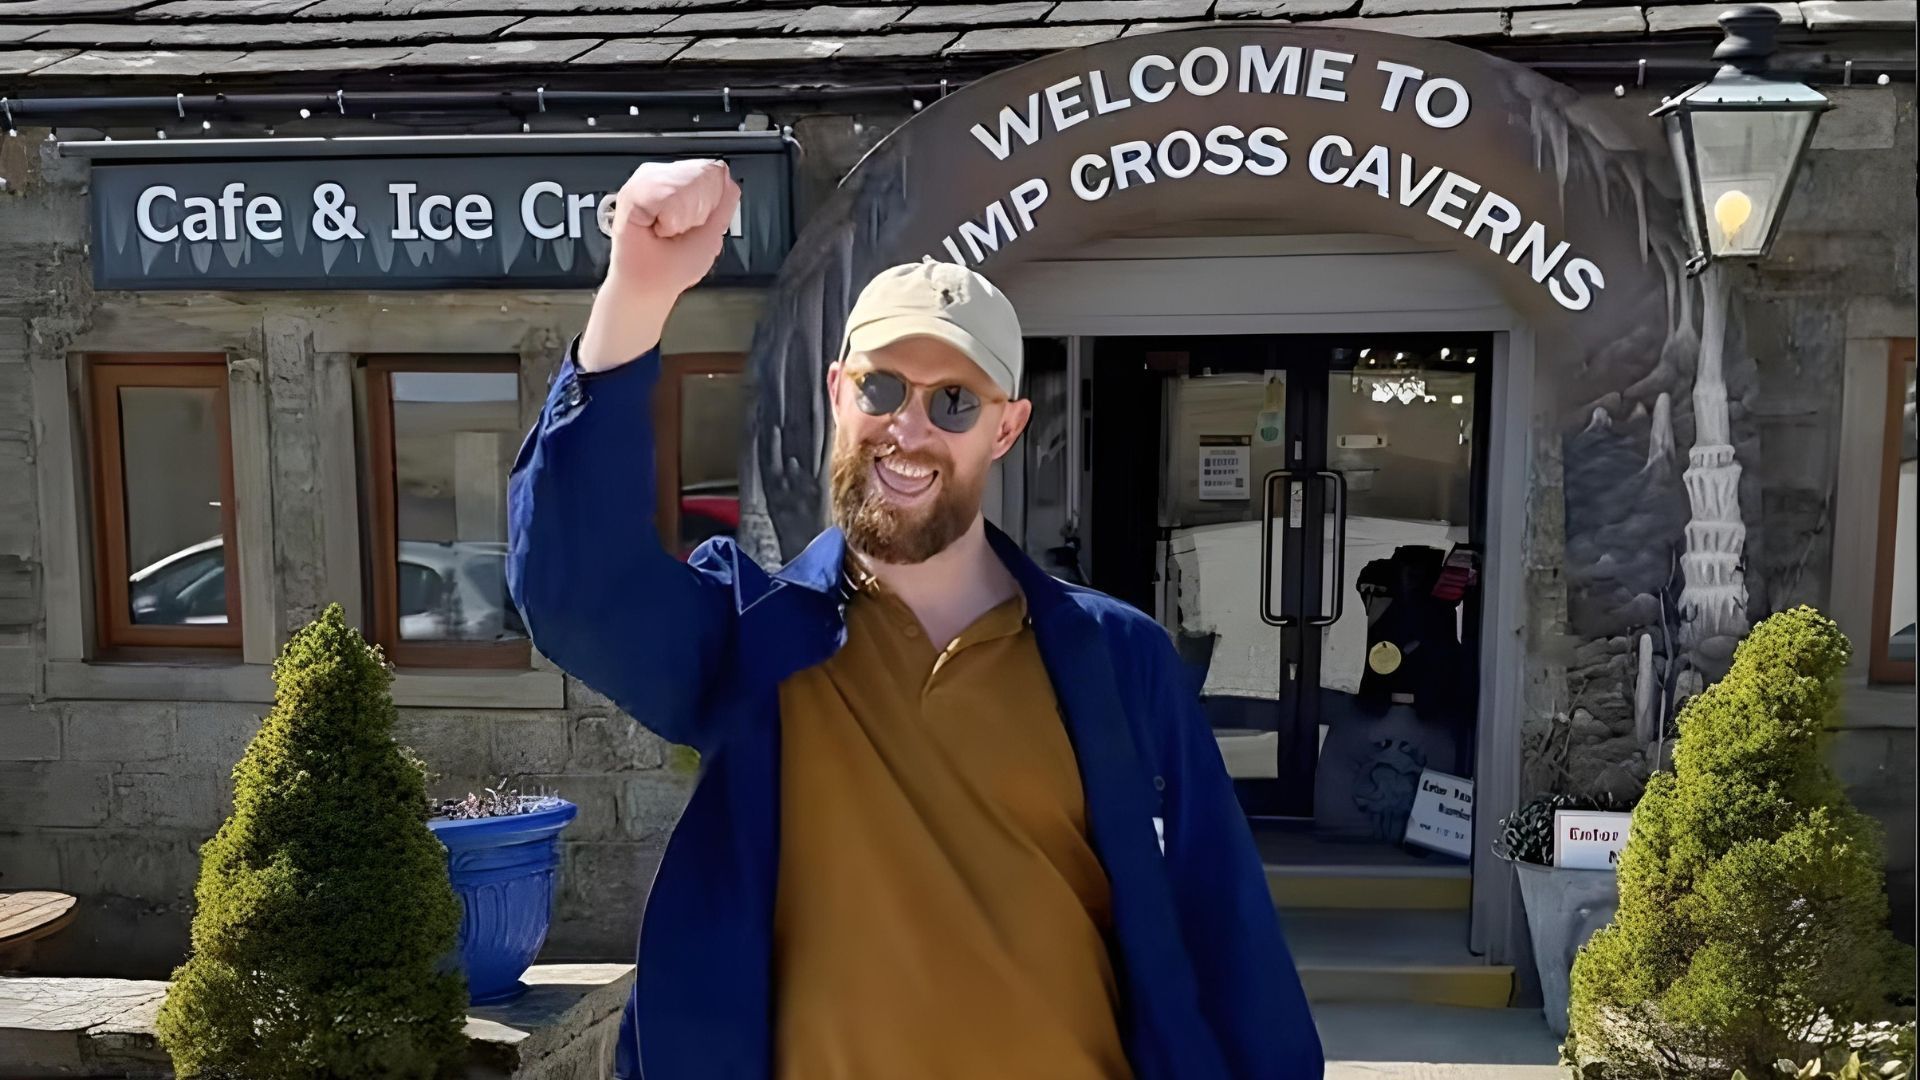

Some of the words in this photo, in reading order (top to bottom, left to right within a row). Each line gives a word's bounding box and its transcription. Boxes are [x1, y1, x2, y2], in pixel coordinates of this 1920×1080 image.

[970, 46, 1355, 161] WELCOME
[1376, 60, 1471, 128] TO
[136, 182, 282, 243] Cafe
[312, 183, 366, 241] &
[388, 183, 493, 240] Ice
[1070, 125, 1289, 201] CROSS
[1308, 134, 1605, 311] CAVERNS
